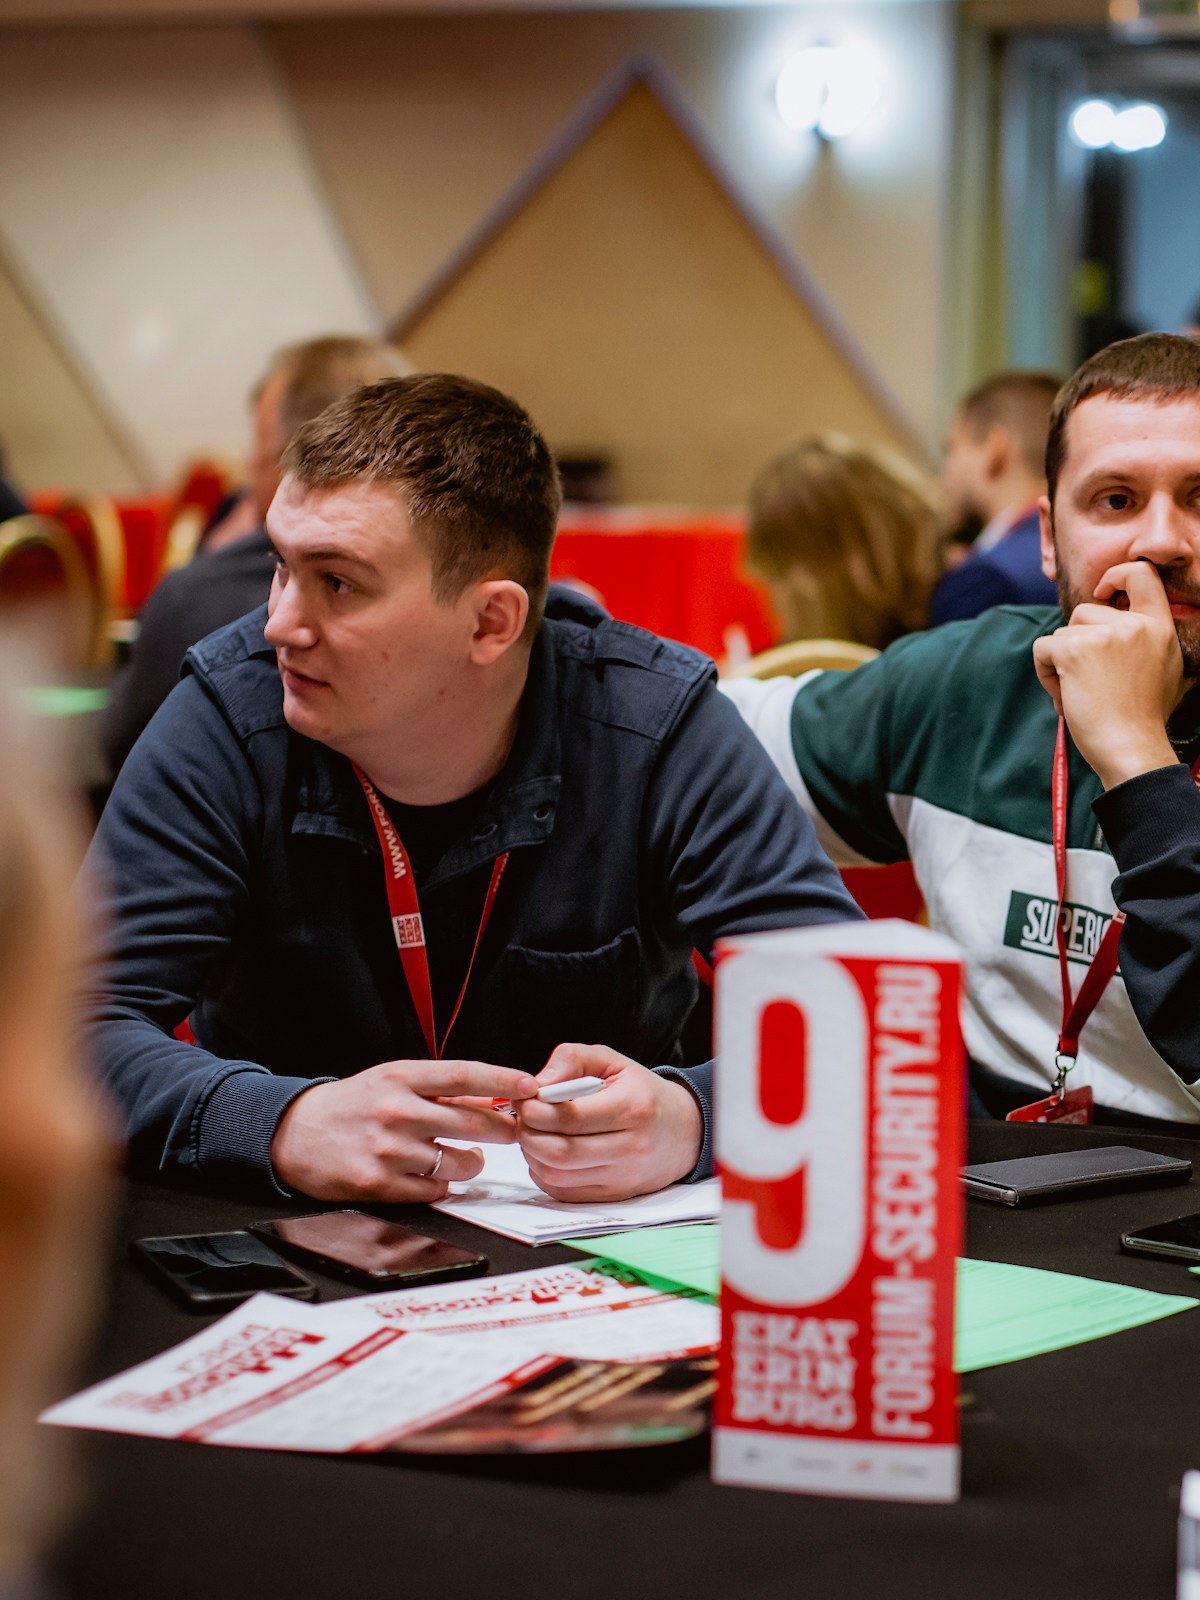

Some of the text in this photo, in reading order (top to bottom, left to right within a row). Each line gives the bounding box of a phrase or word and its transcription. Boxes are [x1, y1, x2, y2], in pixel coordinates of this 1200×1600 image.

[716, 951, 868, 1308] 9
[870, 963, 943, 1438] FORUM-SECURITY.RU
[732, 1311, 858, 1351] EKAT
[732, 1347, 858, 1391] ERIN
[732, 1386, 858, 1431] BURG
